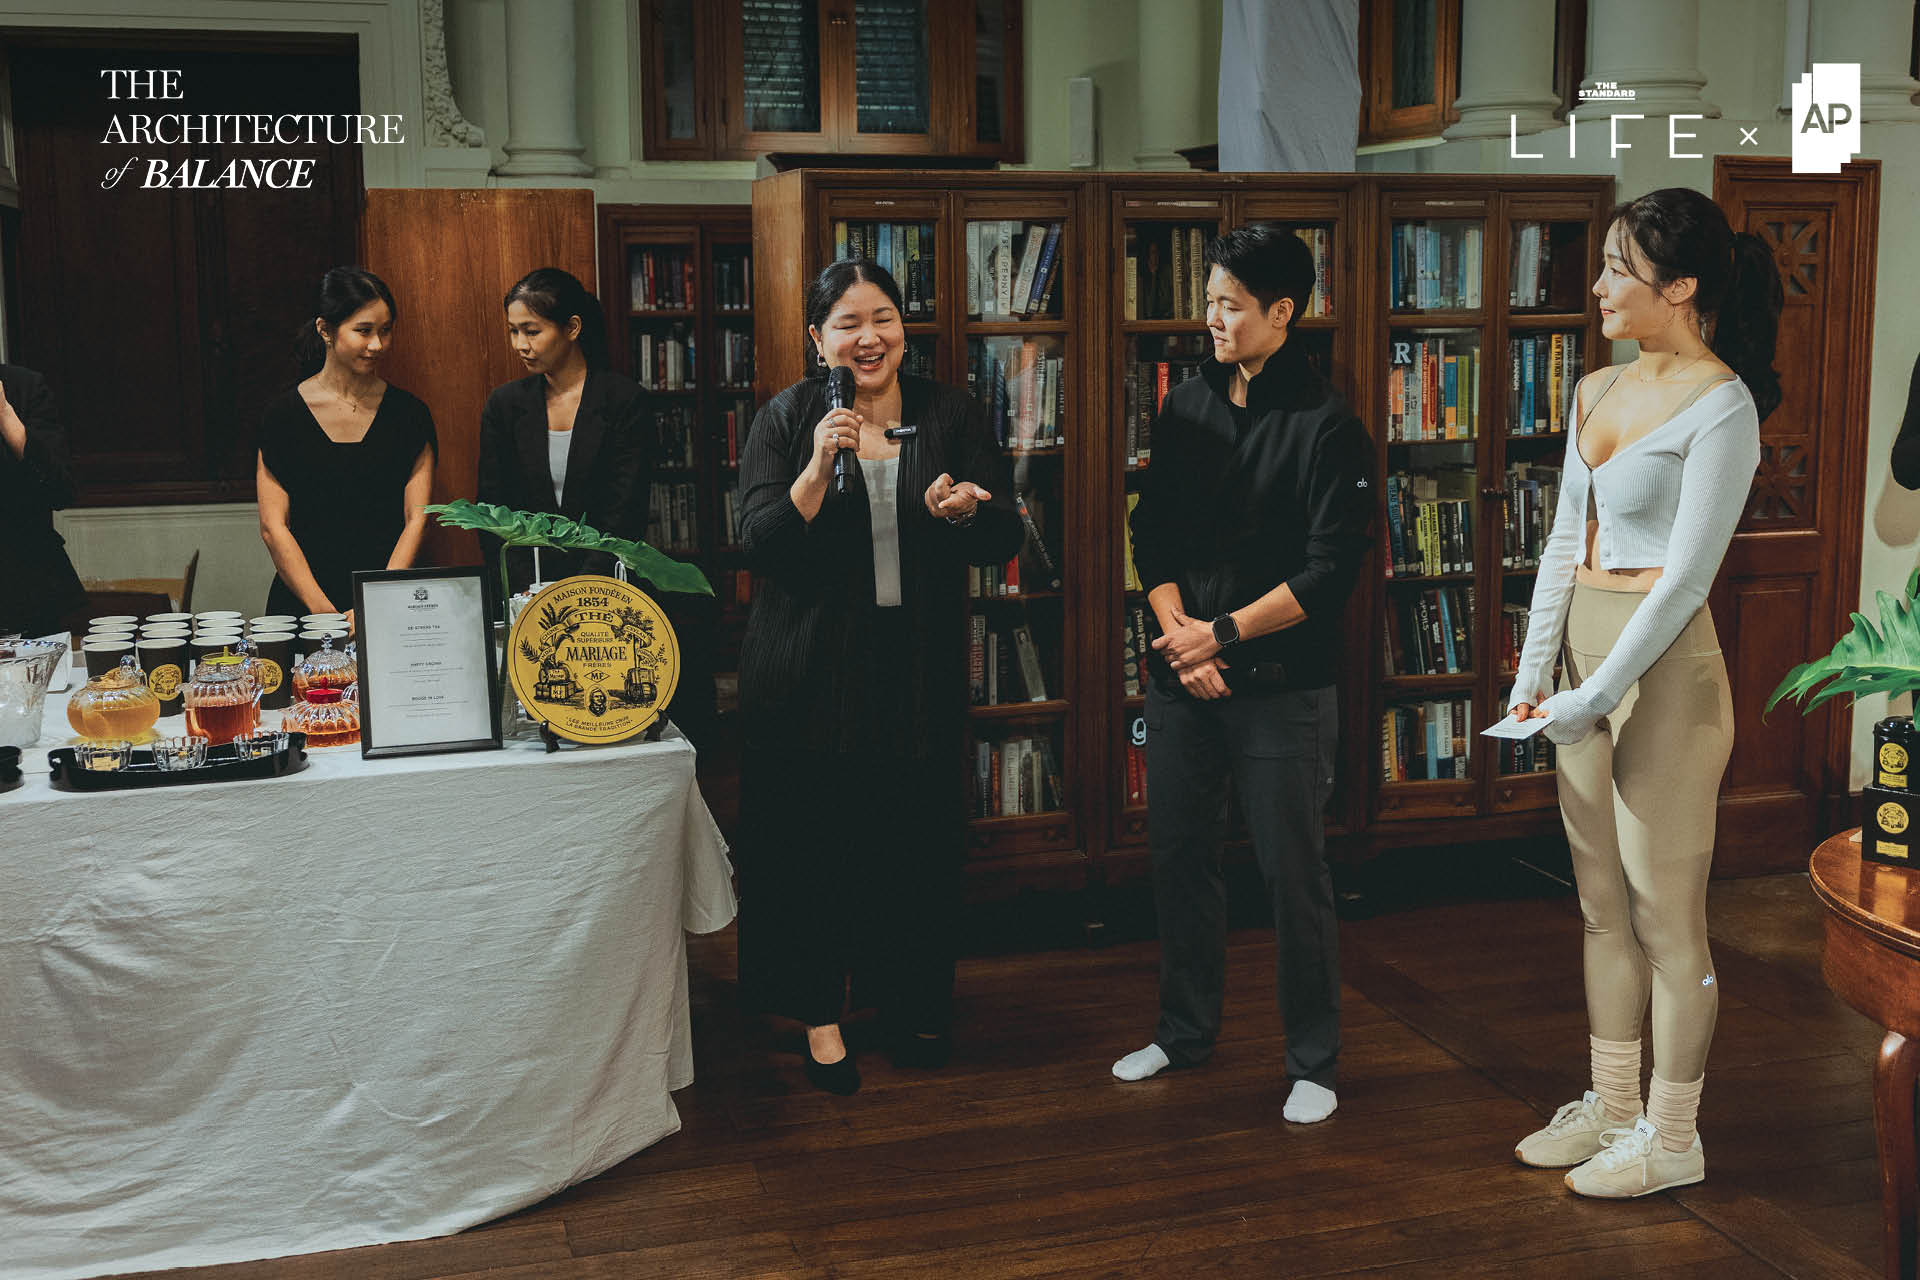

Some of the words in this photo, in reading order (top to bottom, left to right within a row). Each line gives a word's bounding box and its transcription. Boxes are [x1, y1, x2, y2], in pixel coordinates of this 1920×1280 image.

[1394, 342, 1412, 364] R
[553, 586, 587, 604] MAISON
[589, 586, 622, 600] FONDÉE
[621, 595, 633, 605] EN
[576, 597, 609, 607] 1854
[566, 646, 628, 662] MARIAGE
[590, 672, 604, 680] MF
